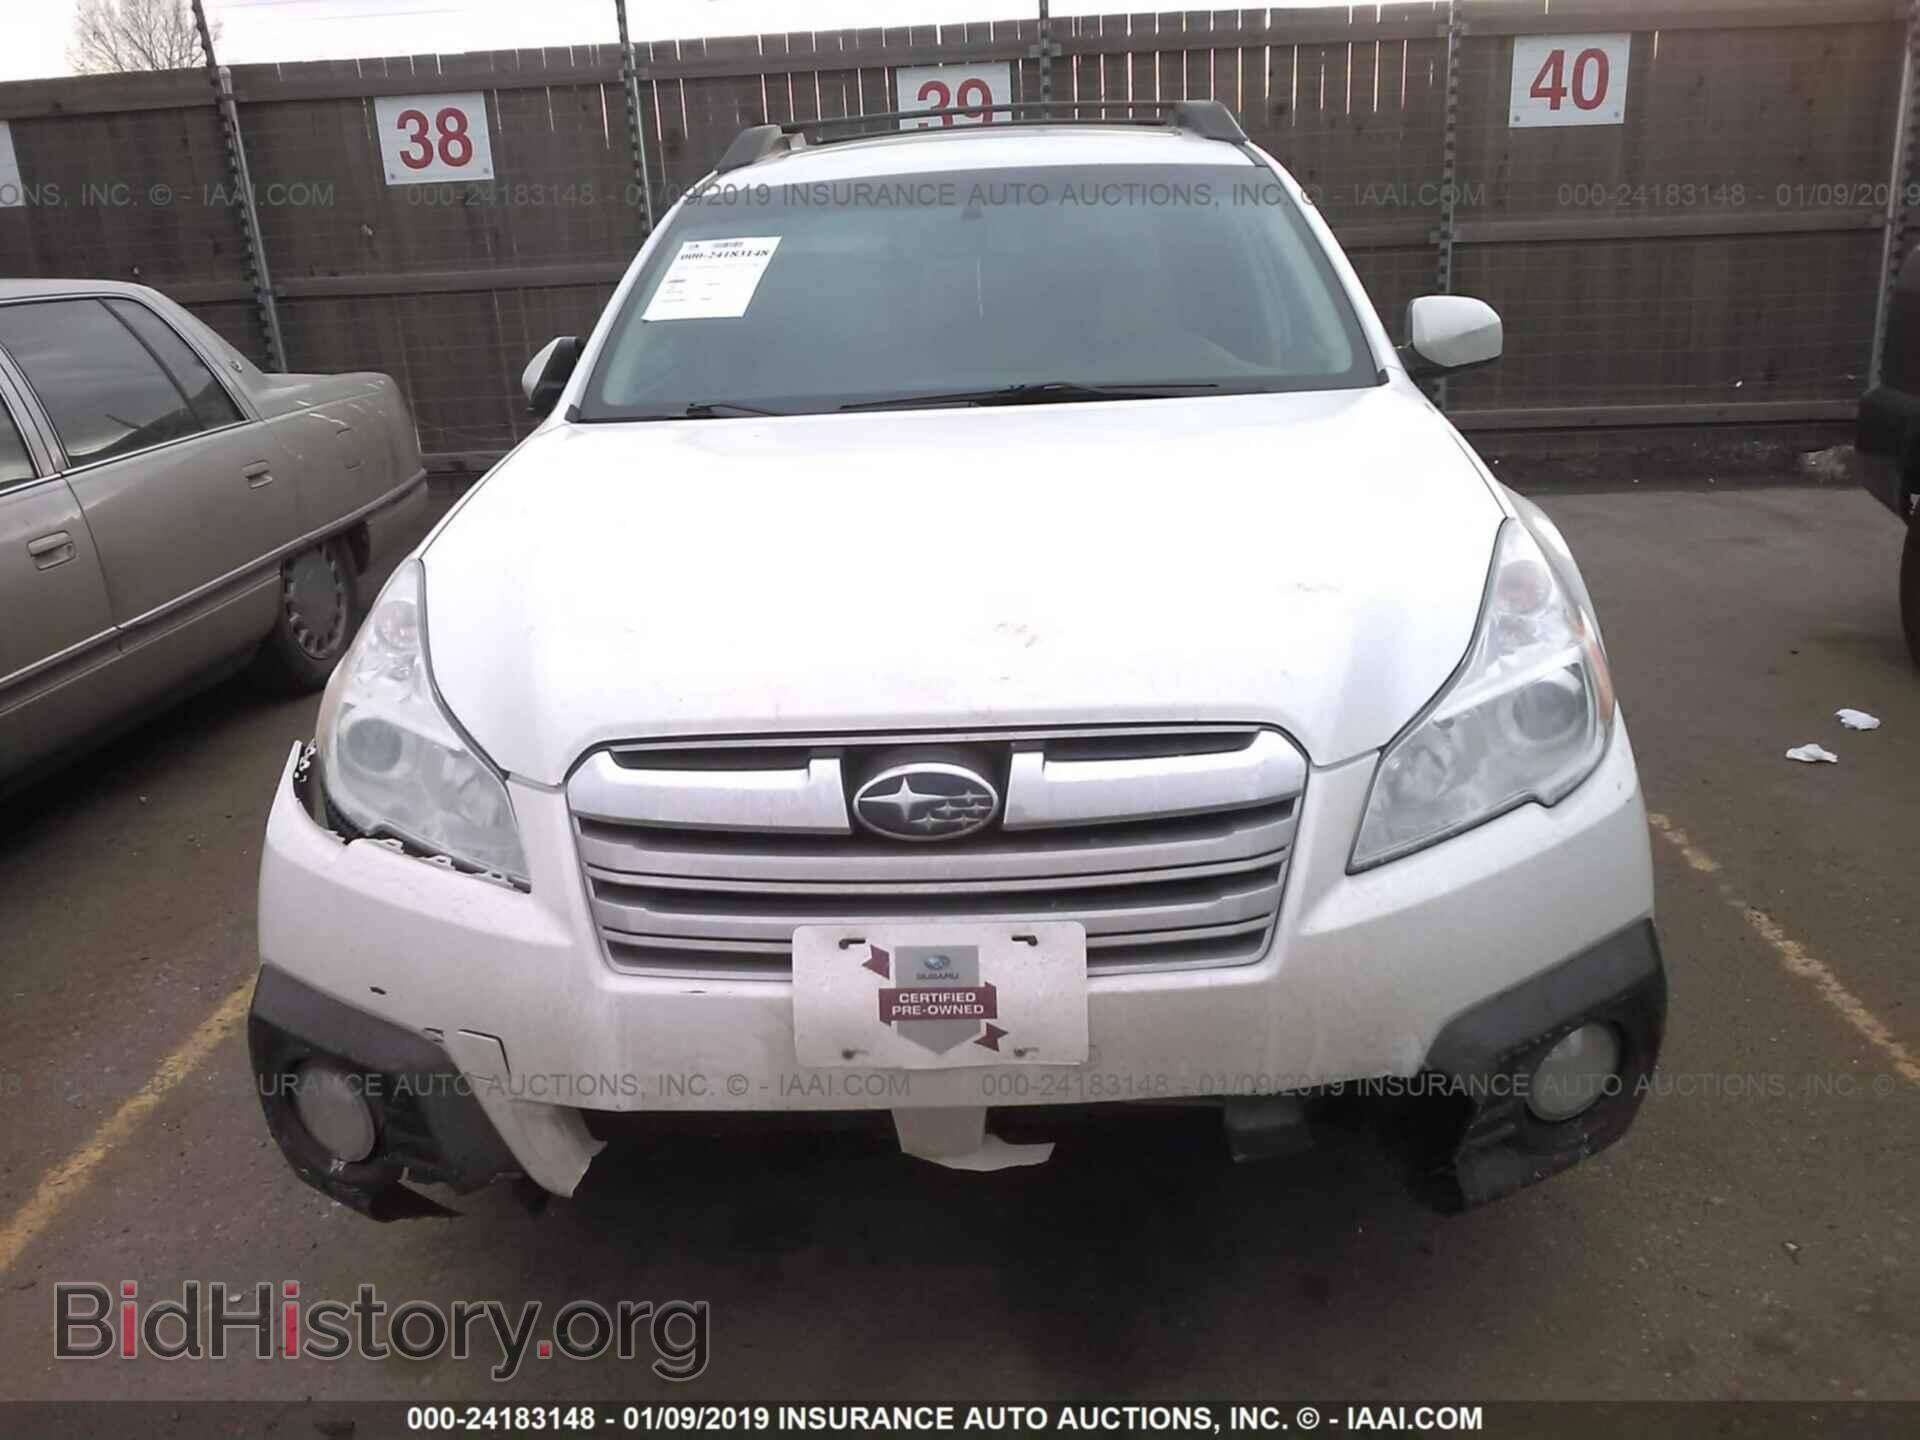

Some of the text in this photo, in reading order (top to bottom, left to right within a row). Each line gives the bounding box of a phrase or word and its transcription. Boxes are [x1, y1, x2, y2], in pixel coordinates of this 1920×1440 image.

[1530, 48, 1610, 111] 40
[917, 78, 993, 128] 39
[397, 107, 473, 169] 38
[916, 971, 960, 981] SUBARU
[892, 1004, 985, 1016] PRE-OWNED
[899, 992, 976, 1004] CERTIFIED
